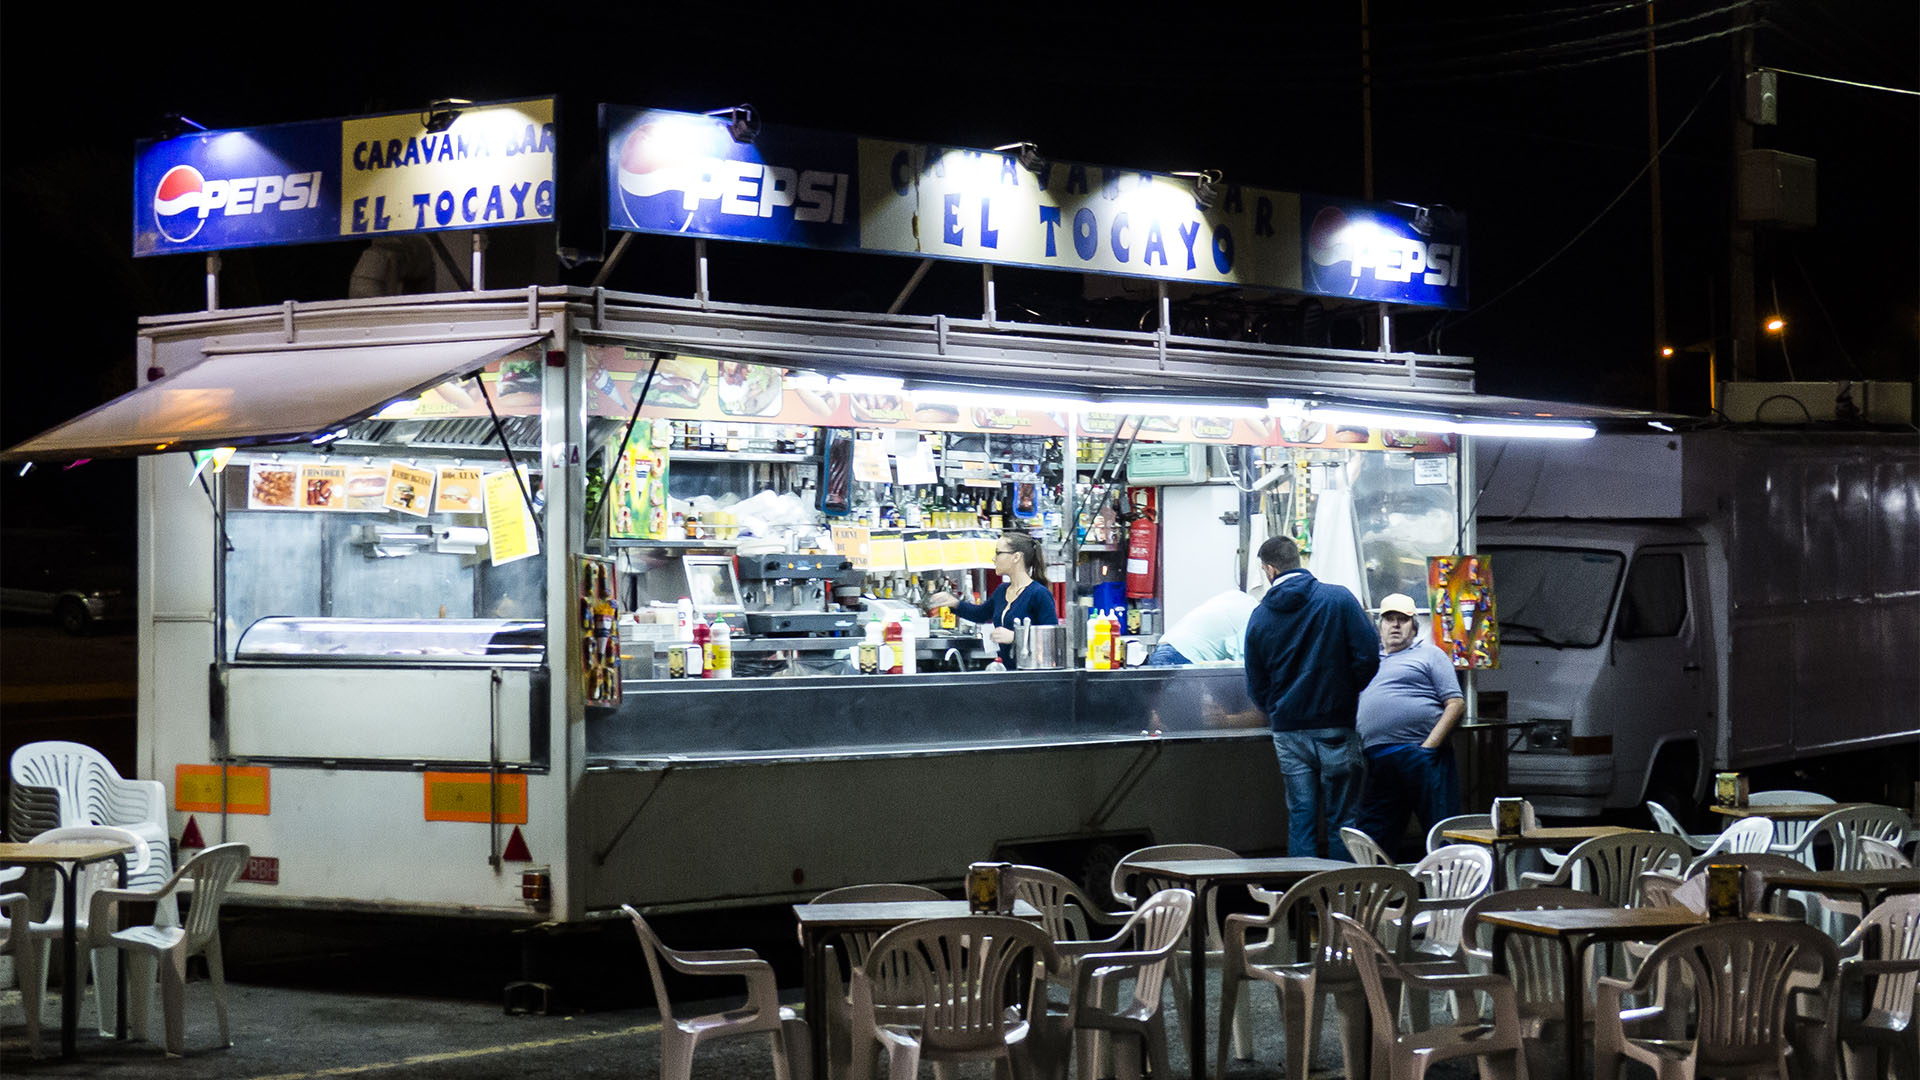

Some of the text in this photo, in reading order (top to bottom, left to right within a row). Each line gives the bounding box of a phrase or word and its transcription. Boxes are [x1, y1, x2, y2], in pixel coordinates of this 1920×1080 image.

[197, 171, 323, 219] PEPSI
[351, 179, 555, 233] EL TOCAYO
[682, 158, 849, 225] PEPSI
[1193, 184, 1275, 238] AR
[942, 192, 1235, 275] EL TOCAYO
[1350, 230, 1461, 287] PEPSI
